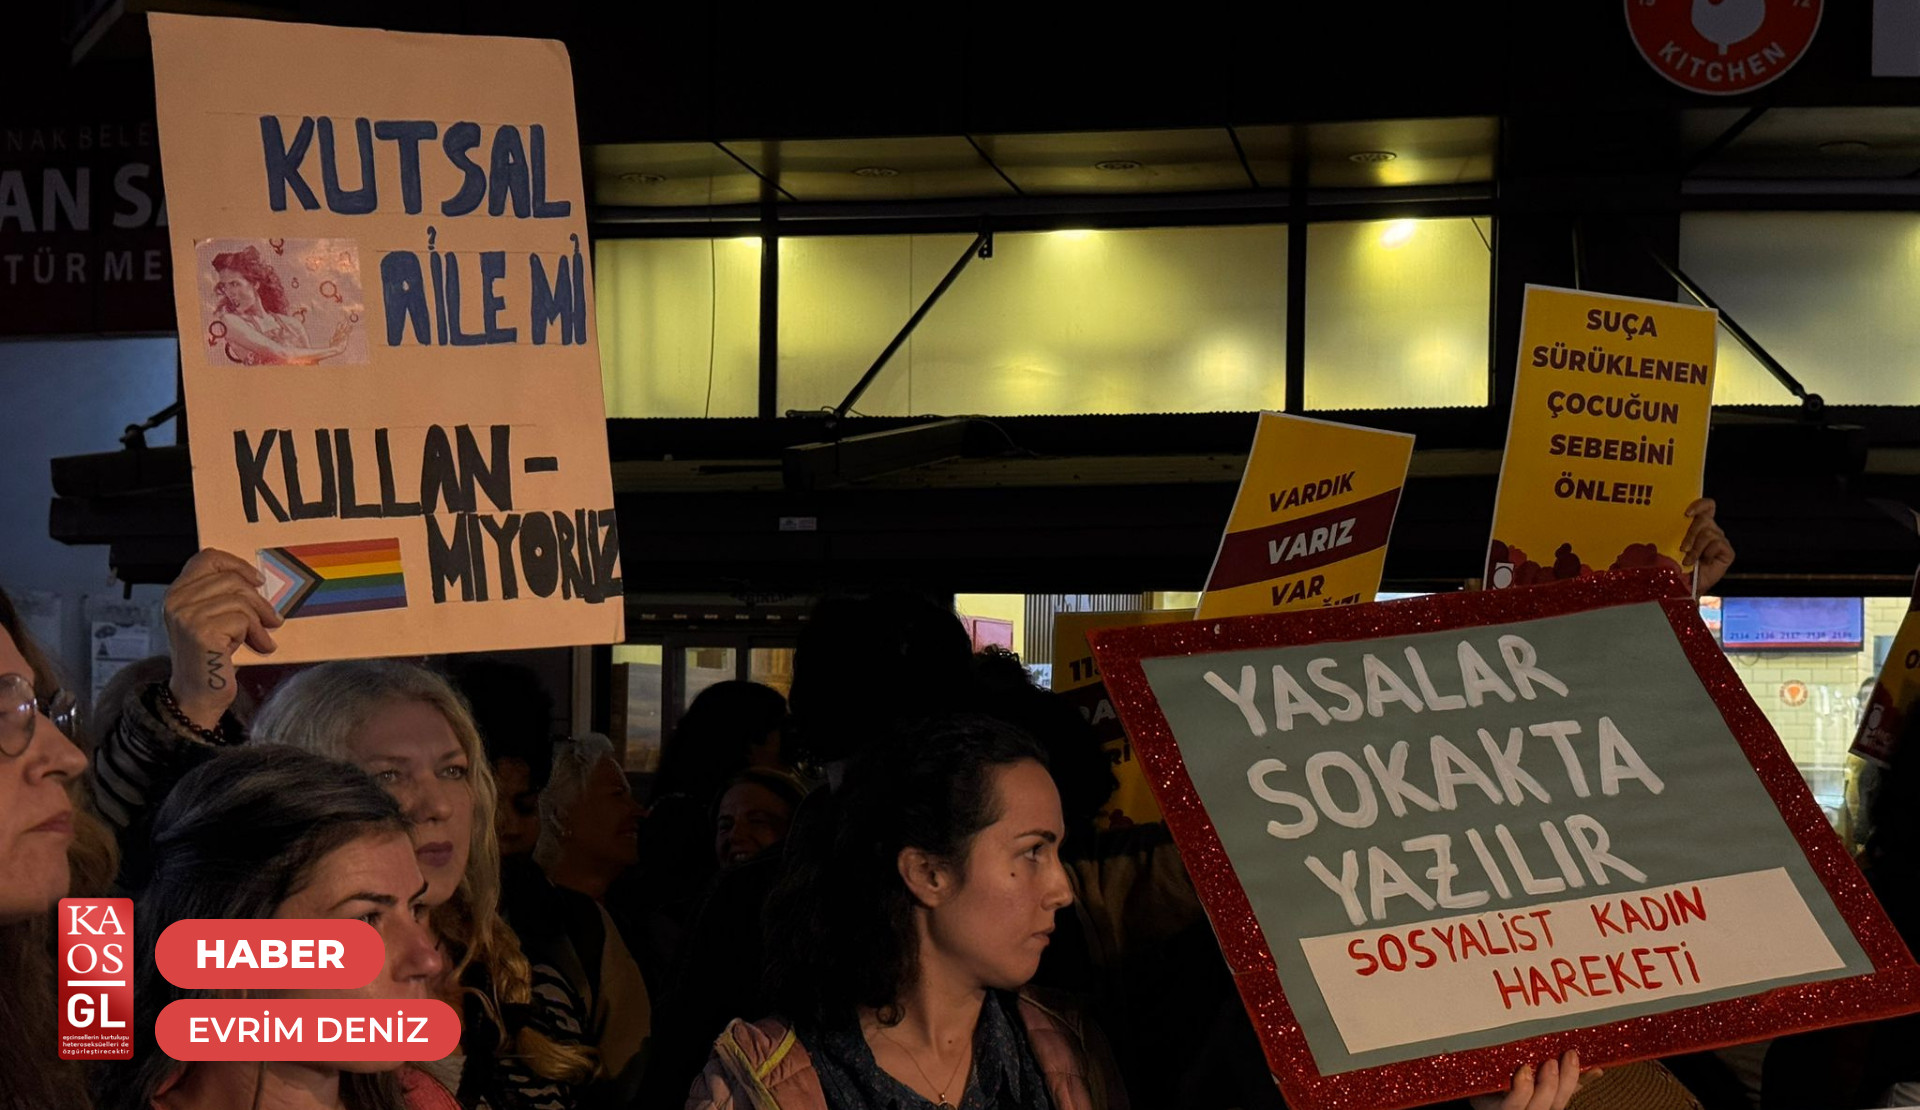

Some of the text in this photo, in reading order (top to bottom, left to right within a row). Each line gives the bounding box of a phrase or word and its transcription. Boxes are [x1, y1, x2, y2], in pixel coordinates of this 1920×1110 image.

[1658, 40, 1786, 82] KITCHEN
[260, 115, 571, 218] KUTSAL
[112, 162, 169, 229] S
[1587, 309, 1657, 340] SUÇA
[1532, 342, 1708, 385] SÜRÜKLENEN
[1547, 391, 1679, 424] ÇOCUĞUN
[1549, 434, 1675, 465] SEBEBİNİ
[1269, 471, 1355, 512] VARDIK
[1554, 471, 1654, 506] ÖNLE!!!
[425, 508, 624, 604] MIYORUZ
[1268, 517, 1357, 565] VARIZ
[1271, 574, 1325, 606] VAR
[1203, 634, 1569, 736] YASALAR
[1246, 716, 1665, 839] SOKAKTA
[1304, 814, 1648, 926] YAZILIR
[1347, 886, 1708, 976] SOSYALİST KADIN
[1493, 941, 1701, 1009] HAREKETİ
